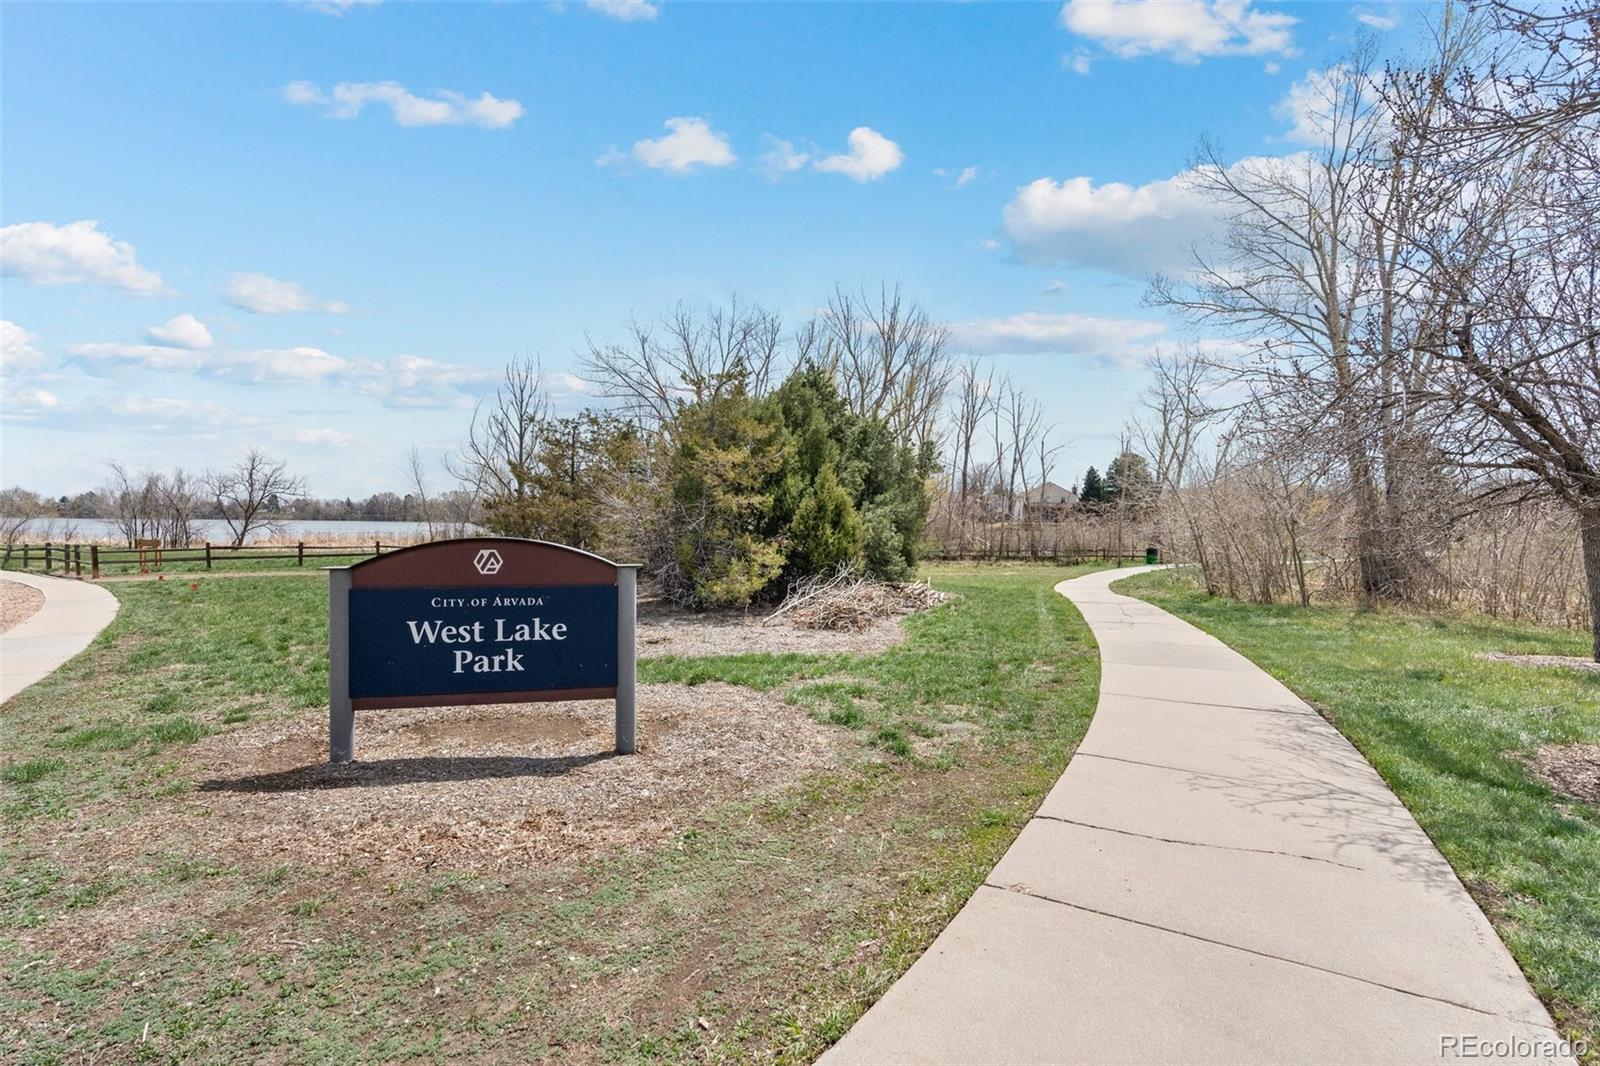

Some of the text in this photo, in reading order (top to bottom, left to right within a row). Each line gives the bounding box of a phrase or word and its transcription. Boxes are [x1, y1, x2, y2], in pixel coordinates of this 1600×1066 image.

[406, 617, 568, 644] West Lake
[452, 648, 525, 674] Park
